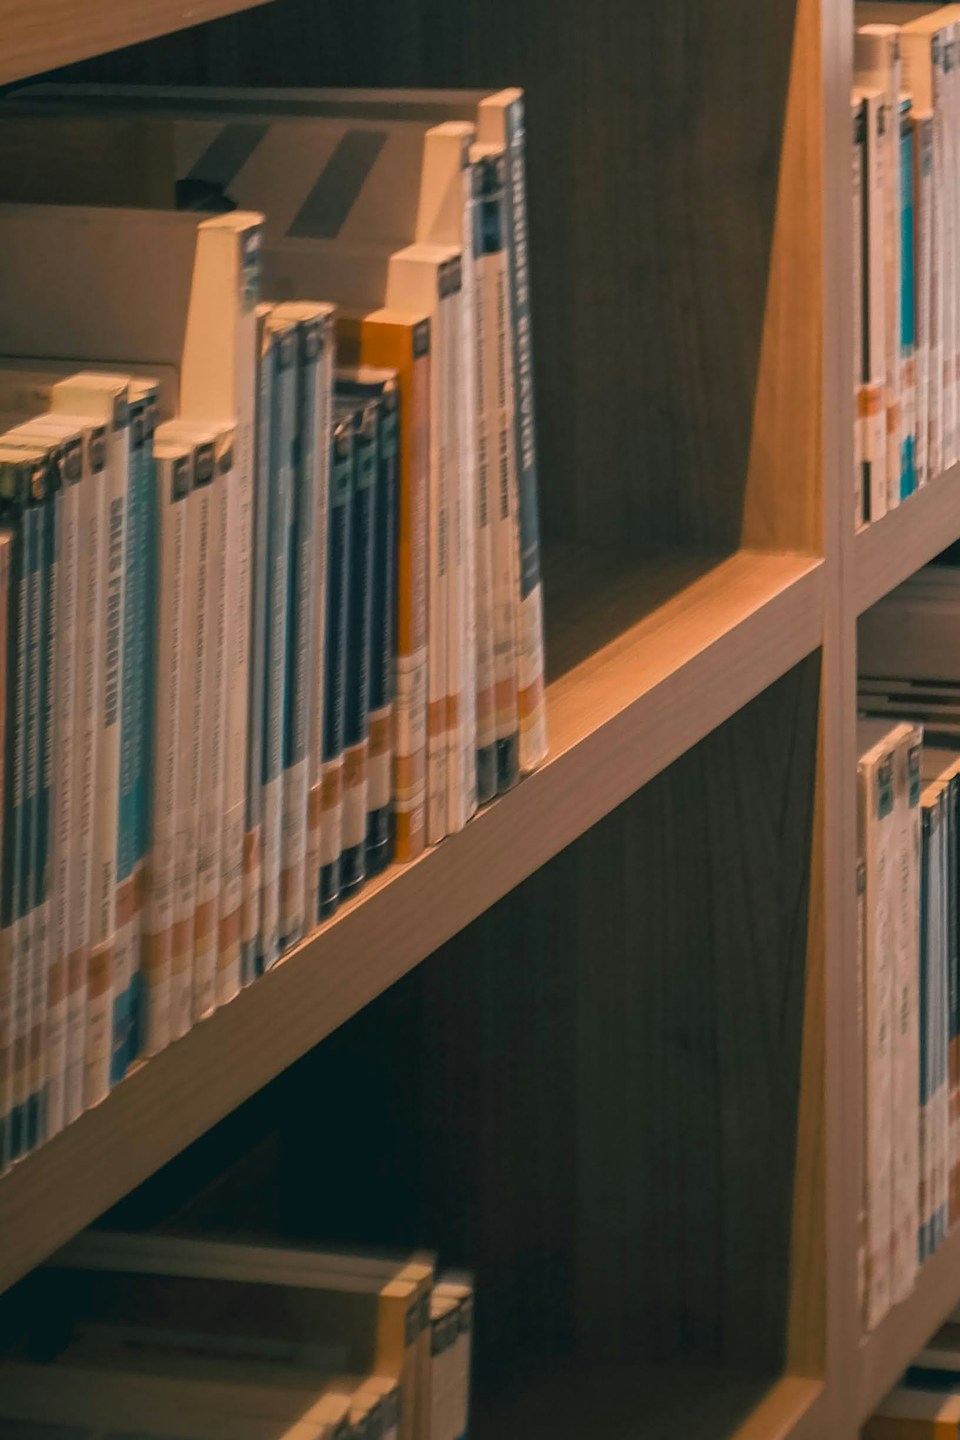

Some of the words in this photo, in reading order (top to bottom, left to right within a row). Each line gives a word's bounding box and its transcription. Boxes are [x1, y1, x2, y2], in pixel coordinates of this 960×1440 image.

[511, 159, 528, 306] ONSUMER
[516, 316, 534, 471] BEHAVIOR
[109, 498, 123, 574] SALES
[501, 456, 510, 519] Internet
[104, 576, 121, 728] PROMOTION
[80, 729, 93, 837] EXCELLENT
